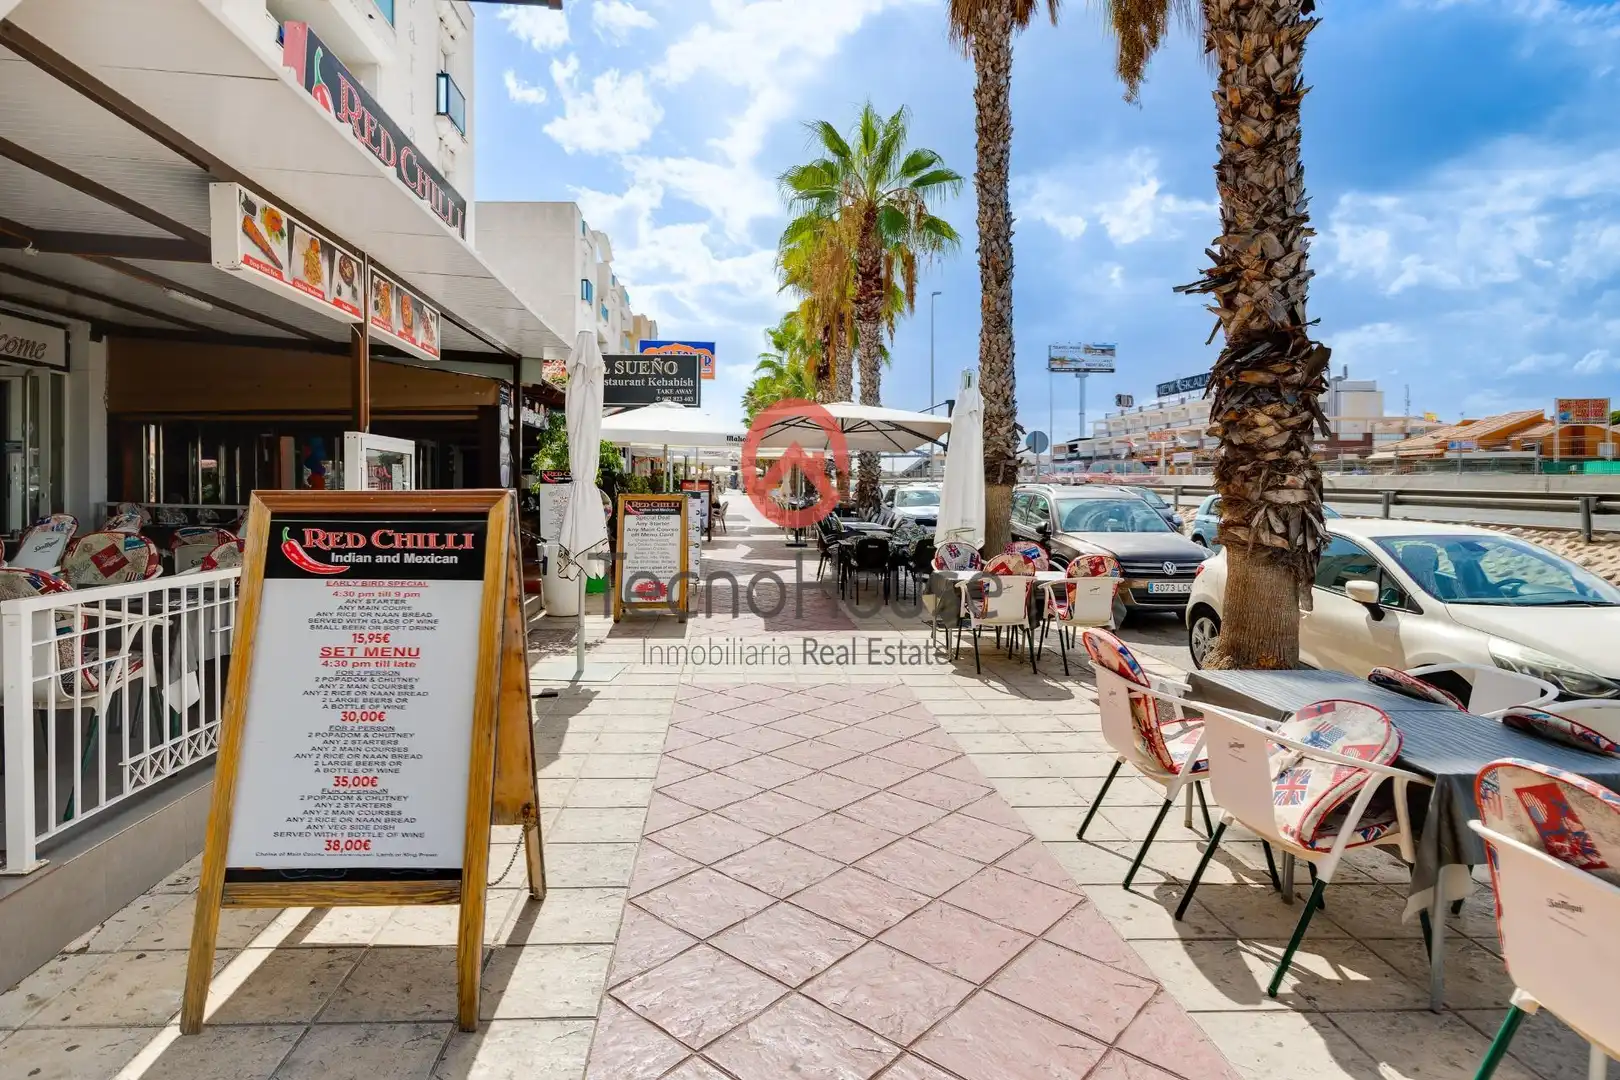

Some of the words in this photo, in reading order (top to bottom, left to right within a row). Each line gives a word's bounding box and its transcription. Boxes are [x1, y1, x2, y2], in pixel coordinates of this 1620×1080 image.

[337, 72, 397, 168] RED
[400, 146, 464, 240] CHILLI
[614, 357, 679, 375] SUEÑO
[648, 376, 694, 387] Kebabish
[302, 528, 367, 550] RED
[371, 529, 475, 549] CHILLI
[331, 553, 372, 564] Indian
[375, 553, 401, 564] and
[403, 553, 459, 564] Mexican
[1155, 584, 1176, 592] 3073
[333, 590, 355, 598] 4:30
[352, 633, 390, 644] 15,95€
[319, 647, 358, 659] SET
[364, 647, 420, 659] MENU
[336, 669, 354, 677] FOR
[372, 683, 416, 691] COURSES
[340, 711, 386, 722] 30,00€
[329, 724, 348, 733] FOR
[358, 725, 396, 733] PERSON
[315, 731, 361, 739] POPADOM
[323, 752, 345, 760] RICE
[333, 776, 379, 788] 35,00€
[358, 809, 403, 817] COURSES
[324, 839, 371, 853] 38,00€
